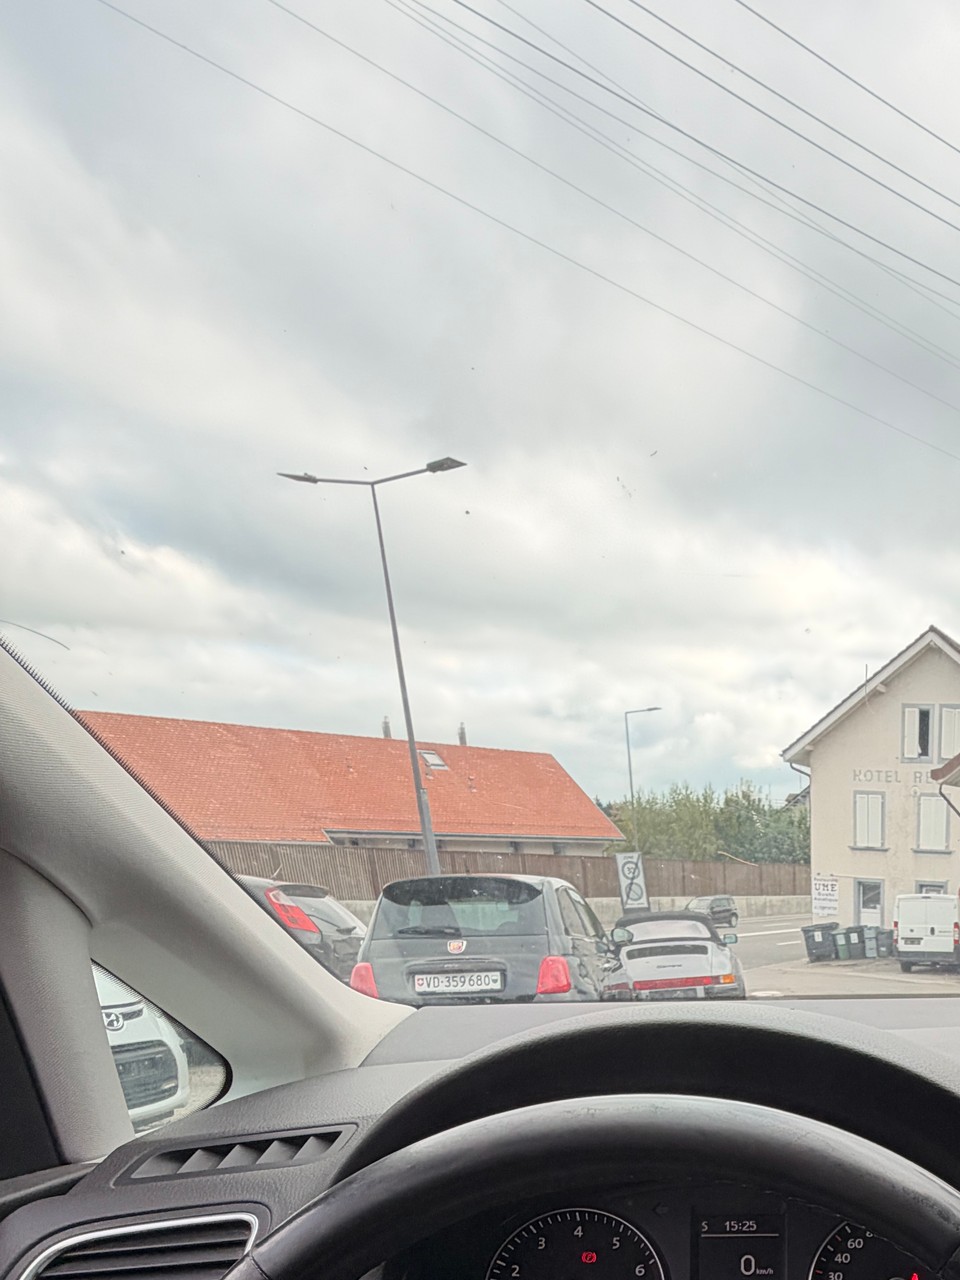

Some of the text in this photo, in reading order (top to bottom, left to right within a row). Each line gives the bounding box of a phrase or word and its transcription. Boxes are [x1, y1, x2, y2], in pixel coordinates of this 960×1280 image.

[853, 769, 934, 785] HOTEL RE
[573, 1226, 584, 1237] 4
[724, 1220, 757, 1231] 15:25
[537, 1237, 546, 1249] 3
[612, 1237, 620, 1249] 5
[847, 1238, 864, 1249] 60
[834, 1253, 850, 1264] 40
[511, 1265, 520, 1277] 2
[635, 1264, 645, 1276] 6
[740, 1254, 755, 1276] 0
